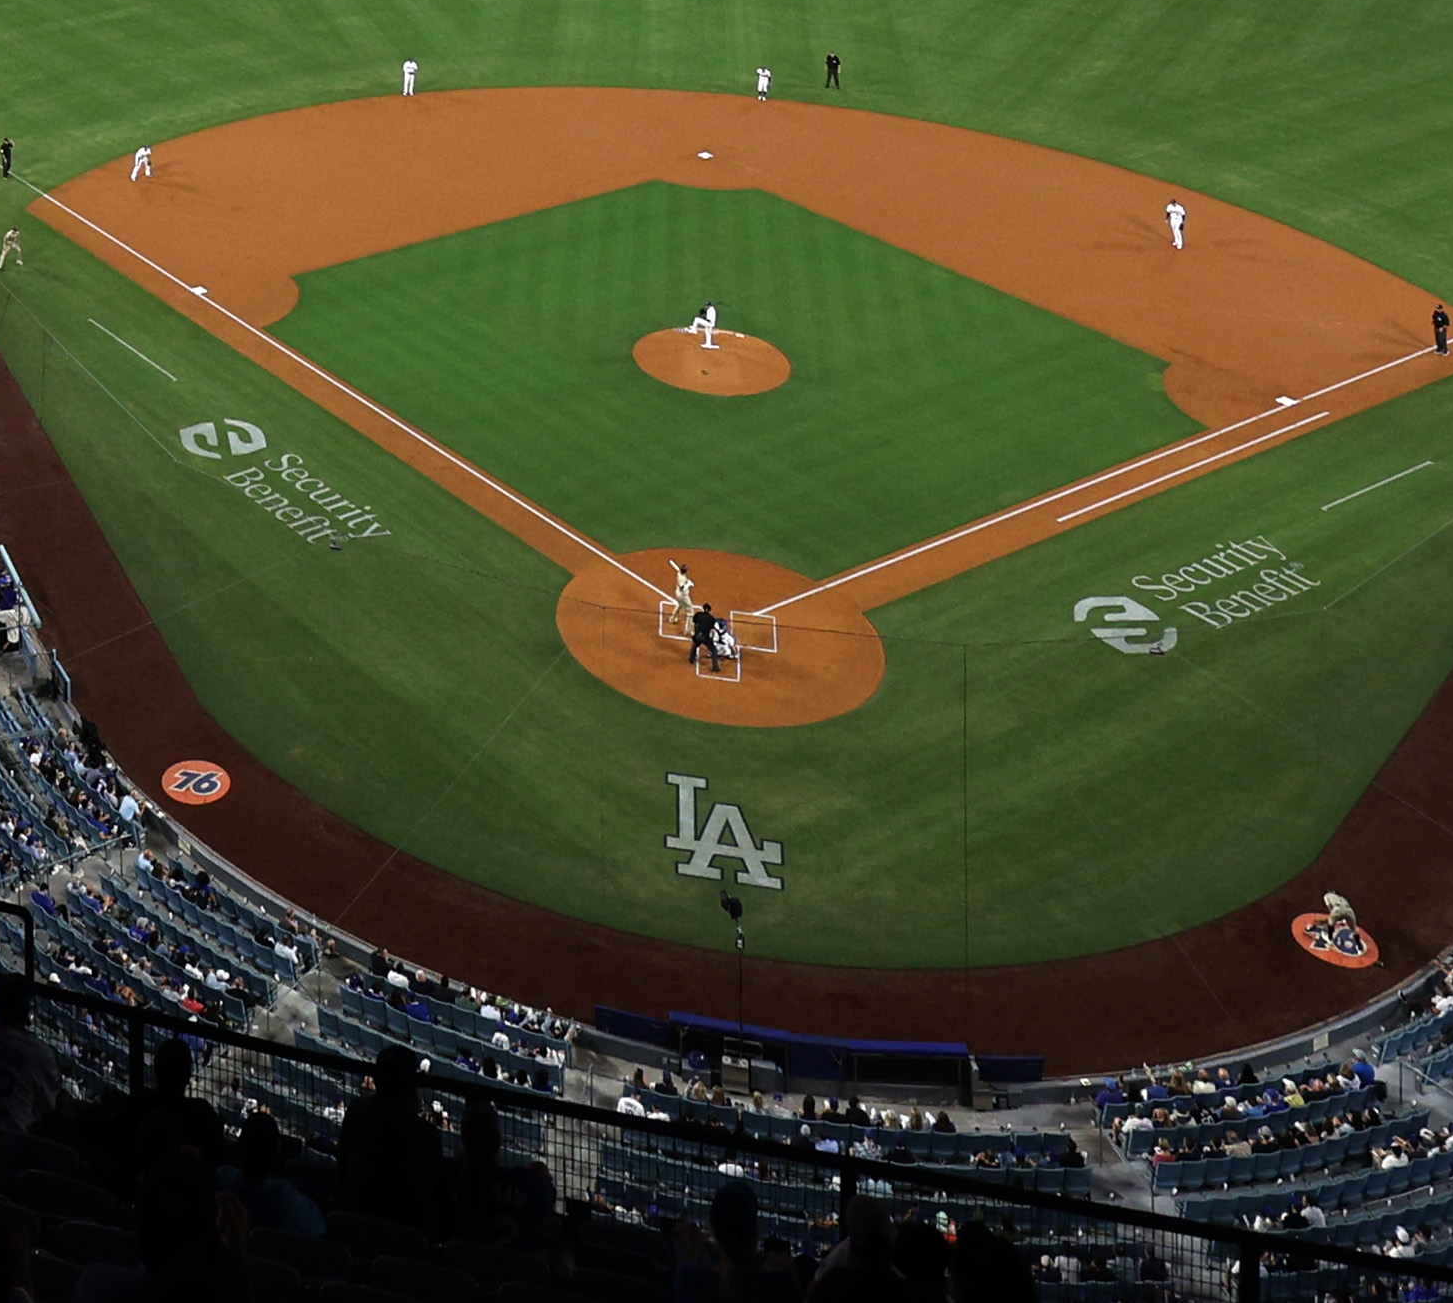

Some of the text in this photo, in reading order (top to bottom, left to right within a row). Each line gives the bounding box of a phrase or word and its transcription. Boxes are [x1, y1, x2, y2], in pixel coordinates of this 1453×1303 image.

[223, 466, 336, 544] Benefit
[265, 453, 391, 541] Security
[1131, 535, 1287, 601] Security
[1179, 565, 1321, 629] Benefit
[169, 769, 223, 796] 76
[665, 772, 784, 890] LA
